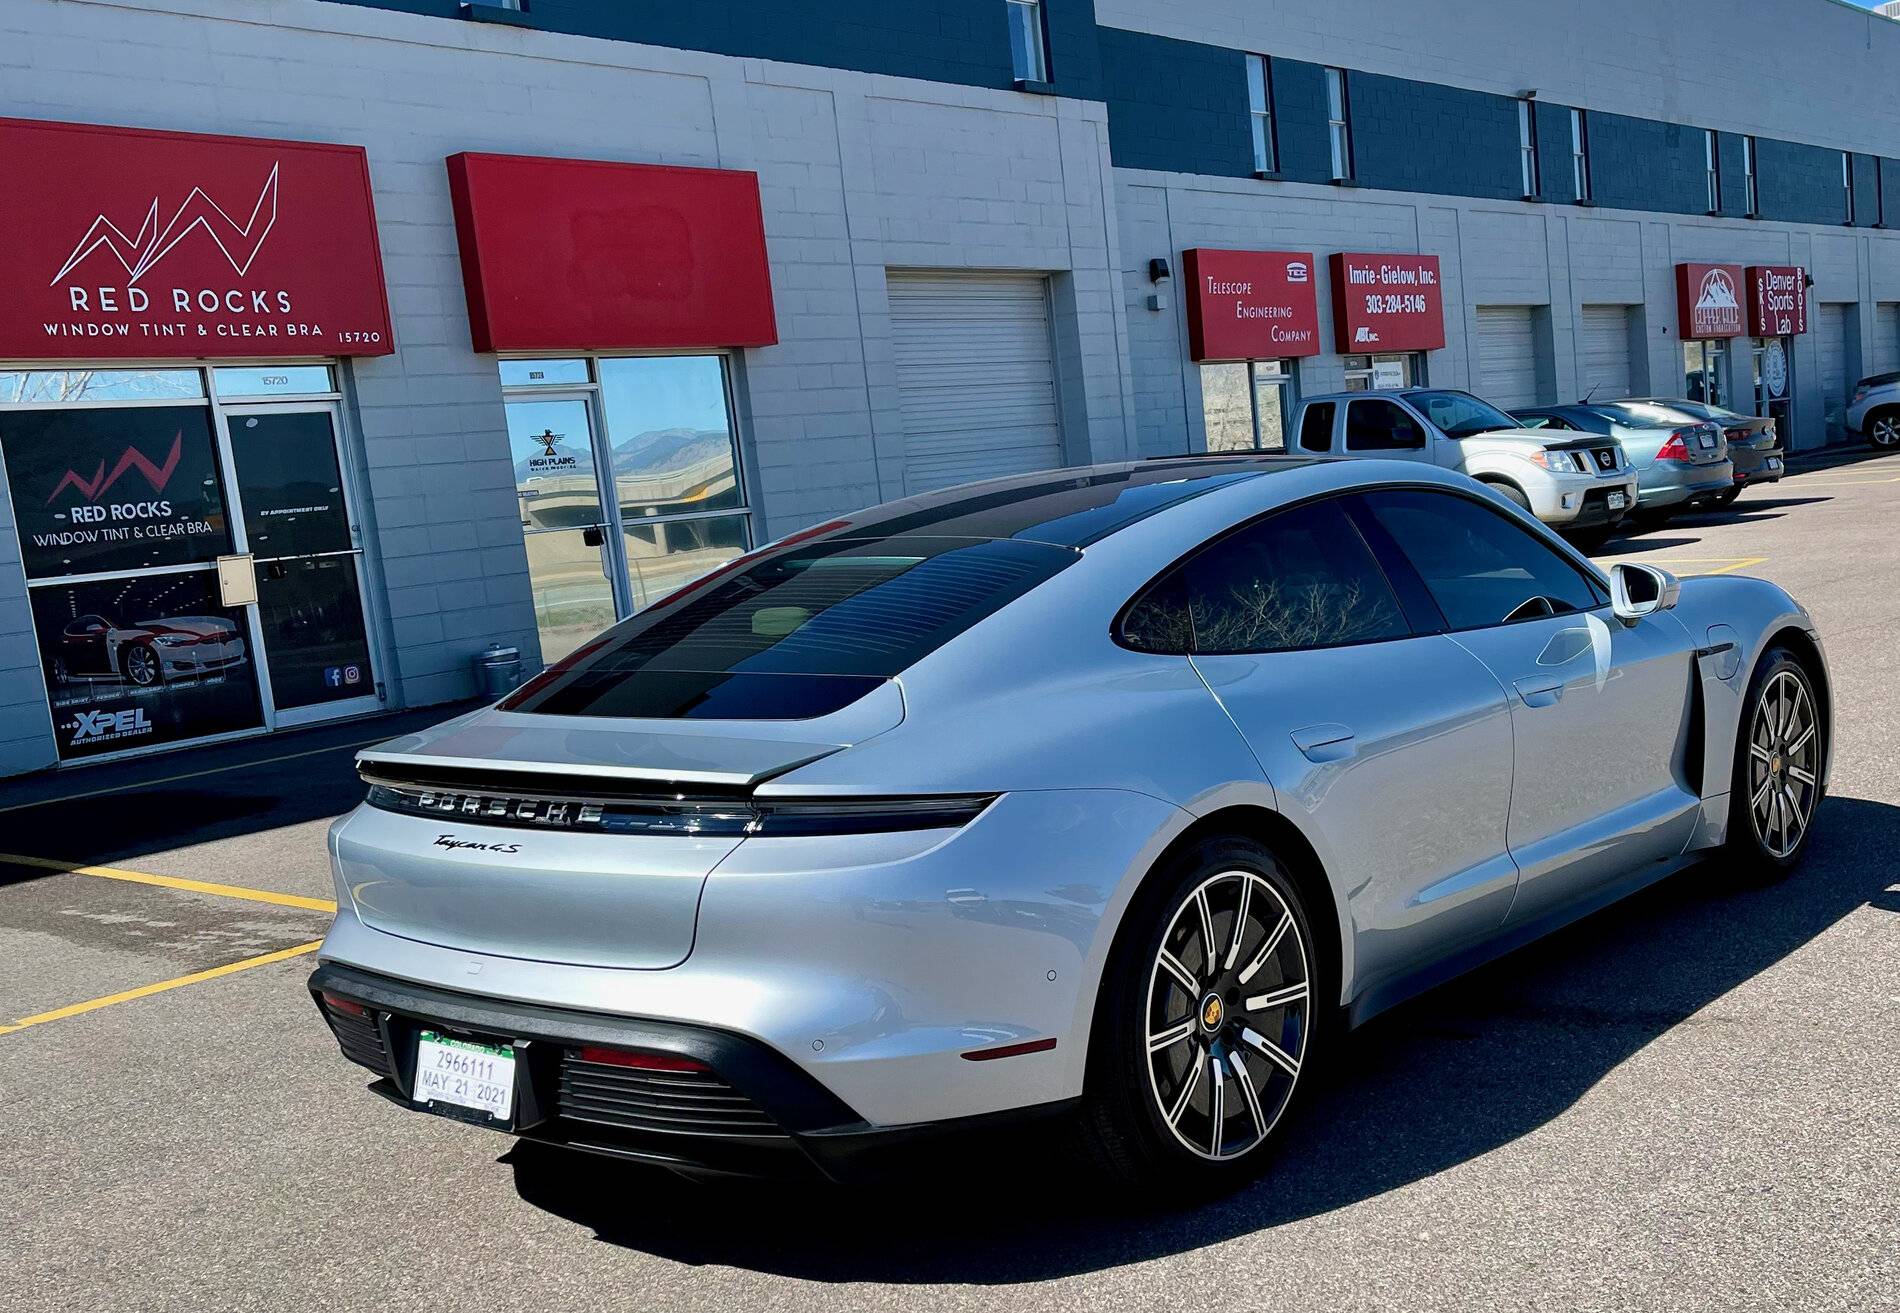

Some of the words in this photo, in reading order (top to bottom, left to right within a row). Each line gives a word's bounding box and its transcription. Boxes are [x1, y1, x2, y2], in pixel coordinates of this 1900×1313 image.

[1419, 266, 1437, 284] Inc.
[1765, 269, 1795, 291] Denver
[69, 286, 149, 312] RED
[172, 288, 291, 314] ROCKS
[1365, 294, 1426, 314] 303-284-5146
[1758, 277, 1766, 331] SKIS
[1767, 291, 1794, 311] Sports
[1796, 267, 1804, 332] BOOTS
[44, 323, 129, 337] WINDOW
[140, 323, 186, 337] TINT
[197, 324, 208, 336] &
[216, 324, 278, 337] CLEAR
[287, 324, 323, 337] BRA
[1774, 310, 1791, 334] Lab
[339, 332, 381, 343] 15720
[529, 458, 547, 467] HIGH
[548, 456, 576, 466] PLAINS
[71, 504, 107, 524] RED
[109, 501, 172, 520] ROCKS
[33, 529, 99, 547] WINDOW
[101, 527, 130, 541] TINT
[133, 527, 144, 539] &
[145, 523, 186, 538] CLEAR
[187, 521, 213, 534] BRA
[73, 707, 152, 739] XPEL
[70, 733, 121, 746] AUTHORIZED
[122, 726, 153, 738] DEALER
[418, 791, 603, 823] PORSCHE
[433, 834, 487, 851] Taycan
[436, 1050, 494, 1081] 2966111
[421, 1070, 449, 1091] MAY
[455, 1078, 469, 1096] 21
[476, 1083, 507, 1105] 2021
